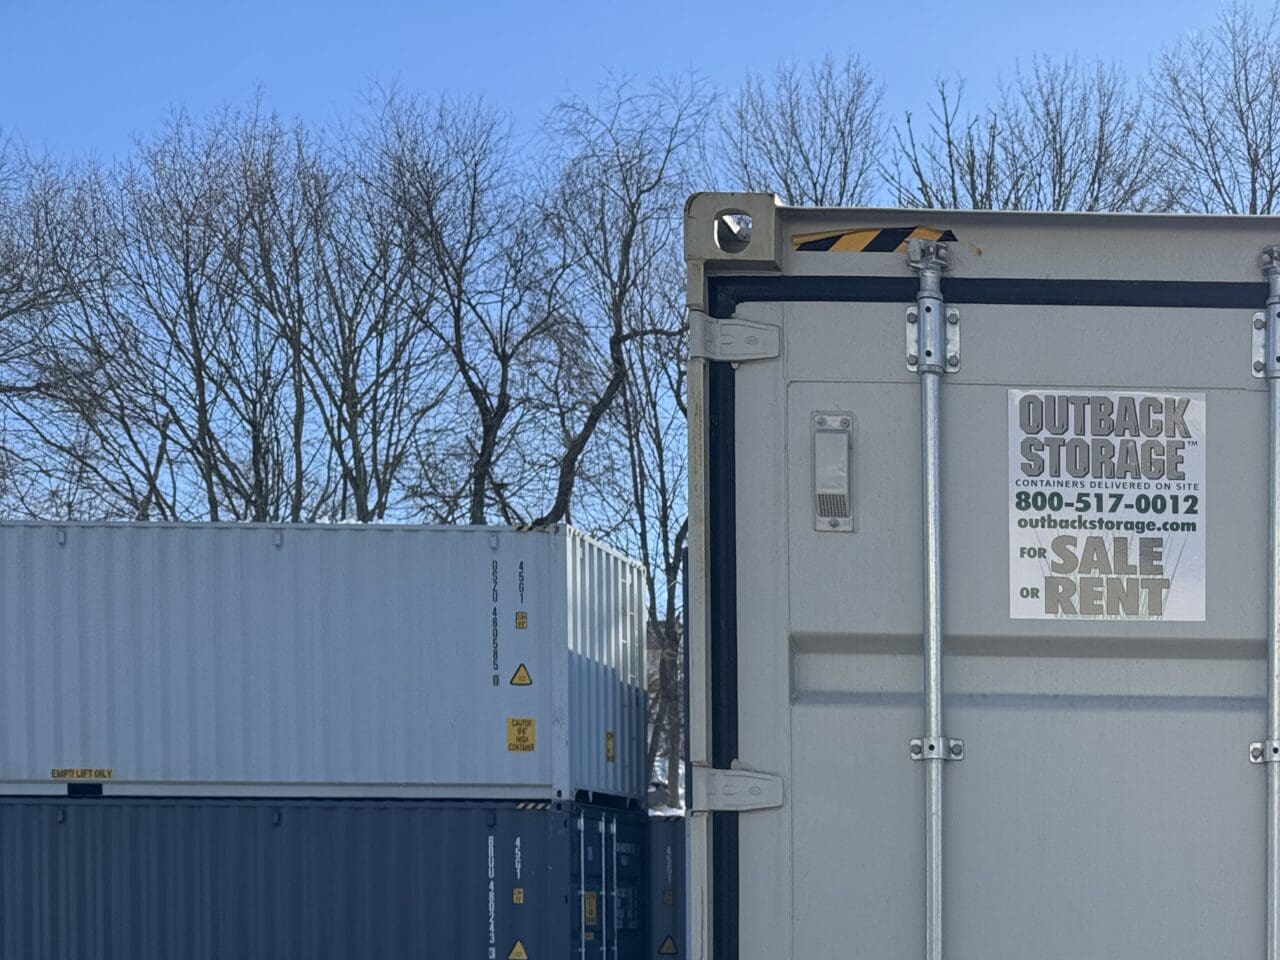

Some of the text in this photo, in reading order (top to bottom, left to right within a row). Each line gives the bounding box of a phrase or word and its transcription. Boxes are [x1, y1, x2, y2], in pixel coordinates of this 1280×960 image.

[1019, 394, 1192, 438] OUTBACK
[1015, 479, 1200, 491] CONTAINERS DELIVERED ON SITE
[1015, 491, 1199, 515] 800-517-0012
[1017, 514, 1197, 534] outbackstorage.com
[1019, 534, 1164, 576] FOR SALE
[1019, 576, 1170, 617] OR RENT
